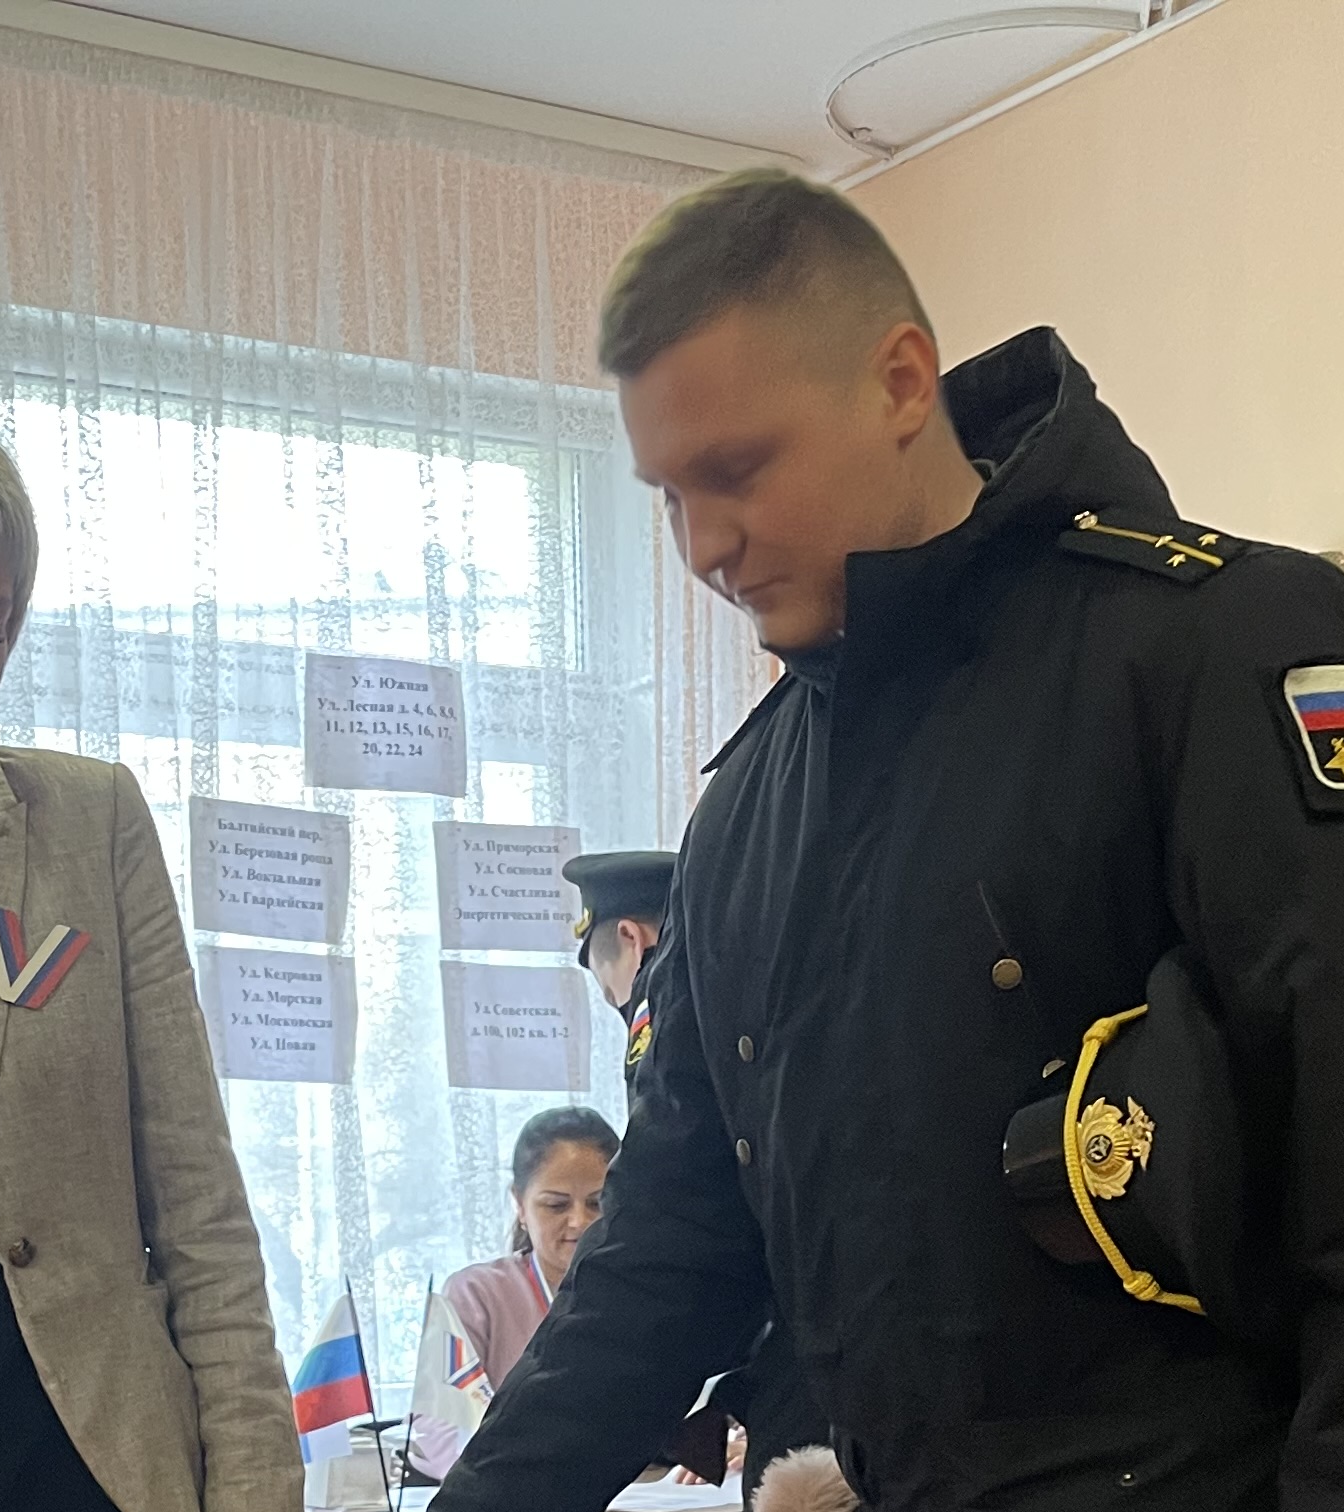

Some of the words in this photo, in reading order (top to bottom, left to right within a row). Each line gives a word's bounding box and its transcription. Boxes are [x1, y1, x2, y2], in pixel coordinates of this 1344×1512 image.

[352, 676, 374, 688] Ул.
[380, 677, 428, 692] Южная
[318, 698, 340, 711] Ул.
[344, 700, 394, 714] Лесная
[408, 744, 423, 757] 24
[218, 818, 295, 838] Балтийский
[234, 842, 298, 860] Березовая
[486, 840, 560, 856] Приморская
[247, 868, 321, 886] Вокзальная
[497, 862, 552, 876] Сосновая
[491, 886, 560, 898] Счастливая
[243, 892, 324, 910] Гвардейская
[453, 907, 550, 922] Энергетический
[264, 967, 322, 983] Кедровая
[267, 990, 322, 1007] Морская
[256, 1014, 333, 1028] Московская
[276, 1038, 316, 1050] Новая
